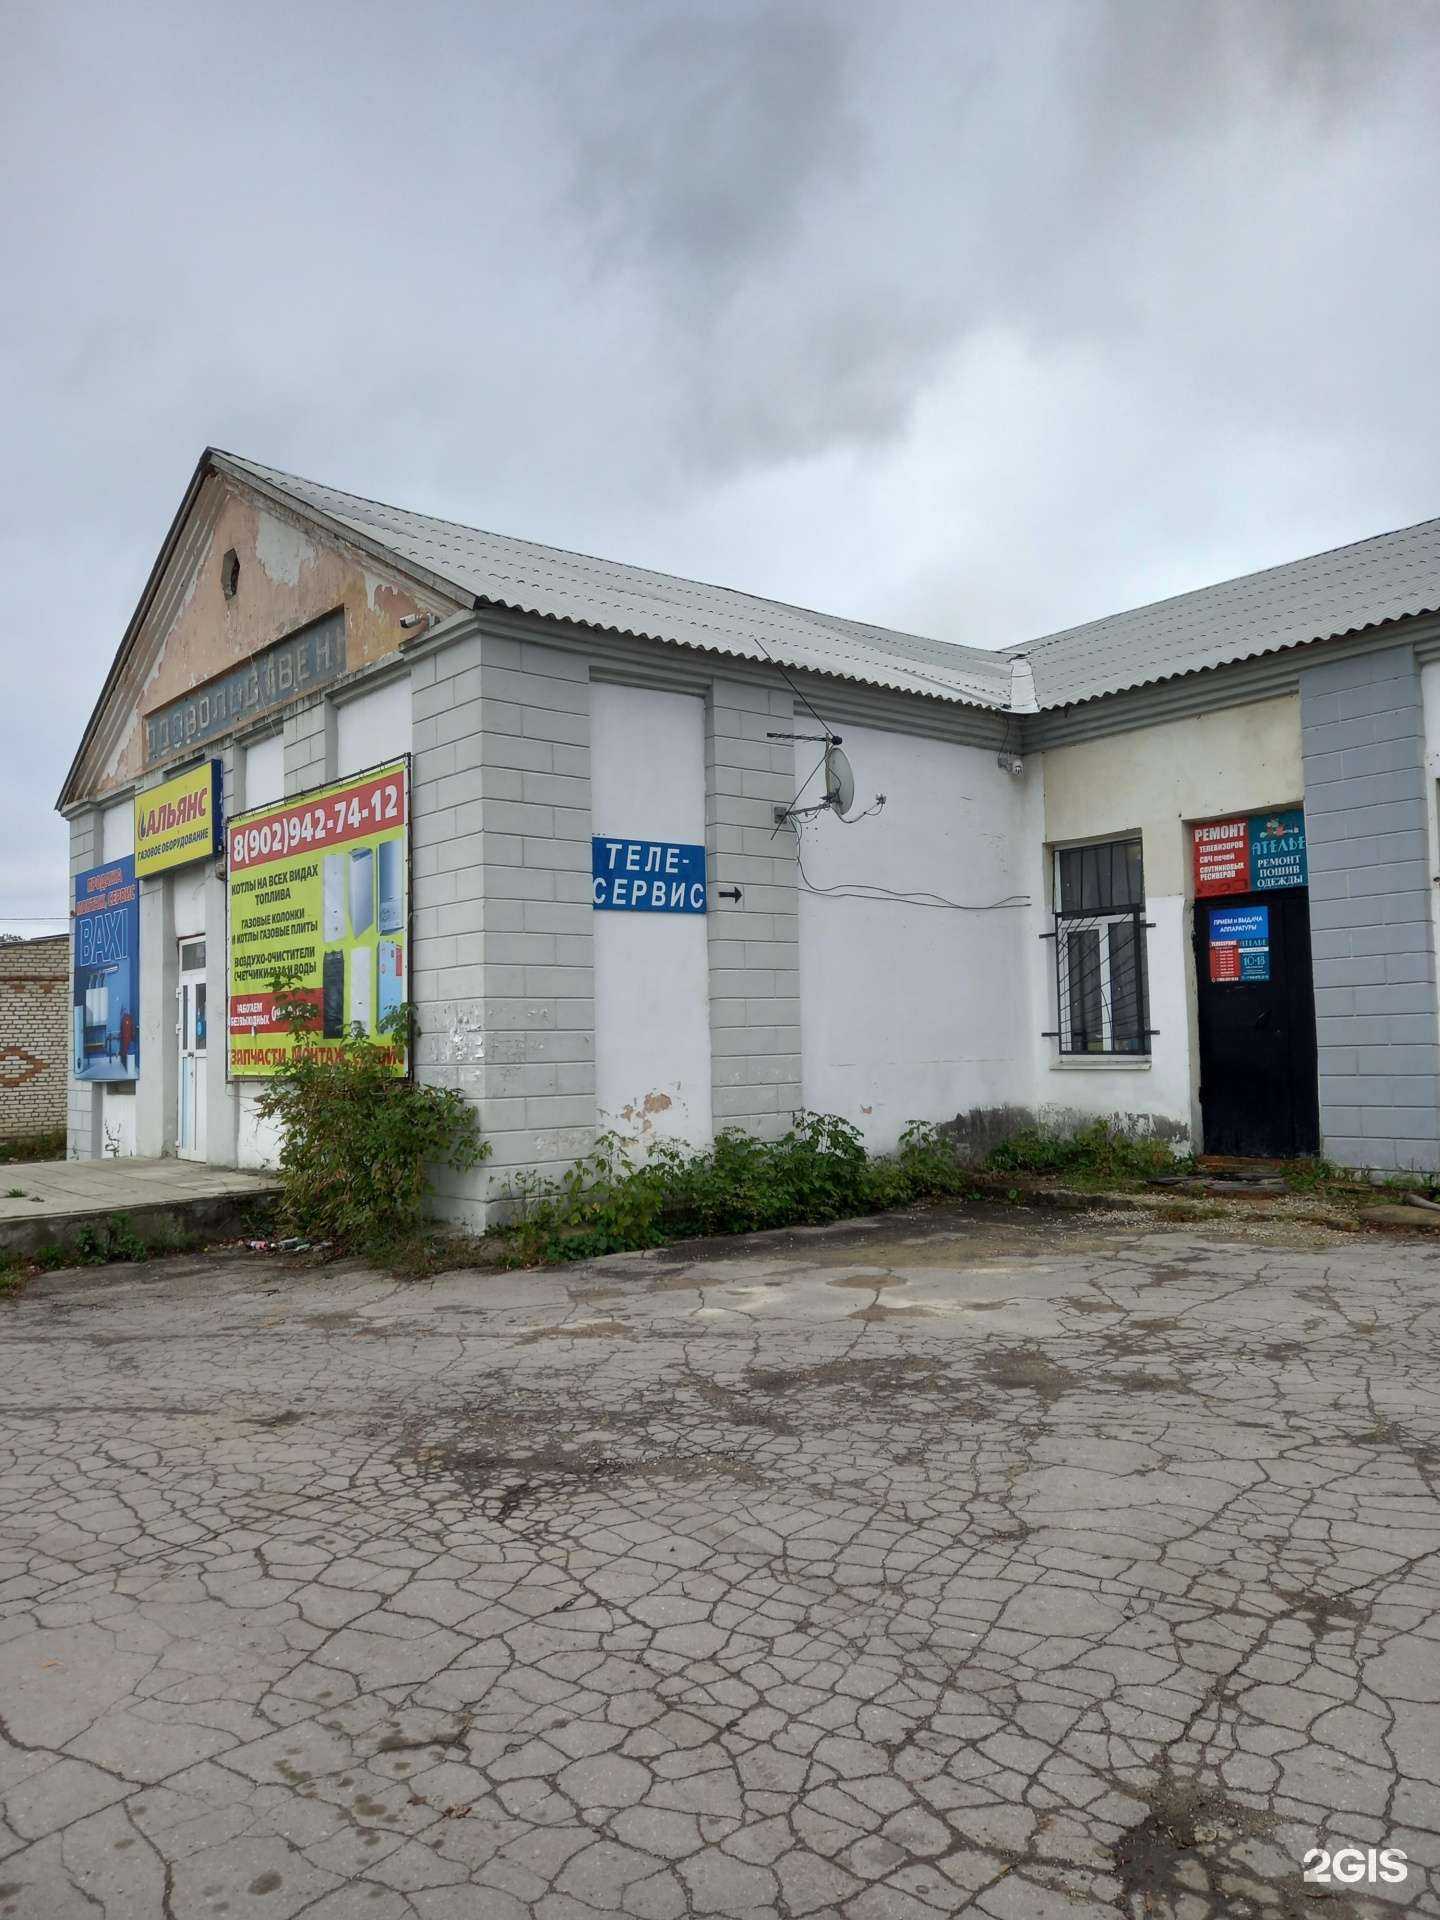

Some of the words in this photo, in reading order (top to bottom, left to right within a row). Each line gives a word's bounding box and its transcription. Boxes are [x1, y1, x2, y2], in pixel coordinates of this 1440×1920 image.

[146, 787, 208, 837] АЛЬЯНС
[233, 784, 398, 864] 8(902)942-74-12
[1194, 822, 1246, 842] РЕМОНТ
[137, 844, 161, 863] ГАЗОВОЕ
[161, 828, 209, 852] ОБОРУДОВАНИЕ
[1200, 840, 1244, 853] ТЕЛЕВИЗОРОВ
[1252, 836, 1306, 855] АТЕЛЬЕ
[606, 843, 690, 874] ТЕЛЕ-
[1257, 855, 1301, 868] РЕМОНТ
[231, 880, 257, 896] КОТЛЫ
[257, 876, 268, 890] НА
[268, 871, 288, 888] ВСЕХ
[289, 864, 319, 883] ВИДАХ
[1257, 875, 1303, 889] ОДЕЖДЫ
[1259, 865, 1300, 878] ПОШИВ
[254, 887, 292, 906] ТОПЛИВА
[593, 877, 704, 909] СЕРВИС
[241, 914, 271, 930] ГАЗОВЫЕ
[271, 908, 305, 925] КОЛОНКИ
[80, 908, 129, 967] BAXI
[236, 930, 259, 945] КОТЛЫ
[259, 924, 290, 942] ГАЗОВЫЕ
[291, 920, 319, 937] ПЛИТЫ
[234, 946, 316, 968] ВОЗДУХО-ОЧИСТИТЕЛИ
[293, 961, 317, 977] ВОДЫ
